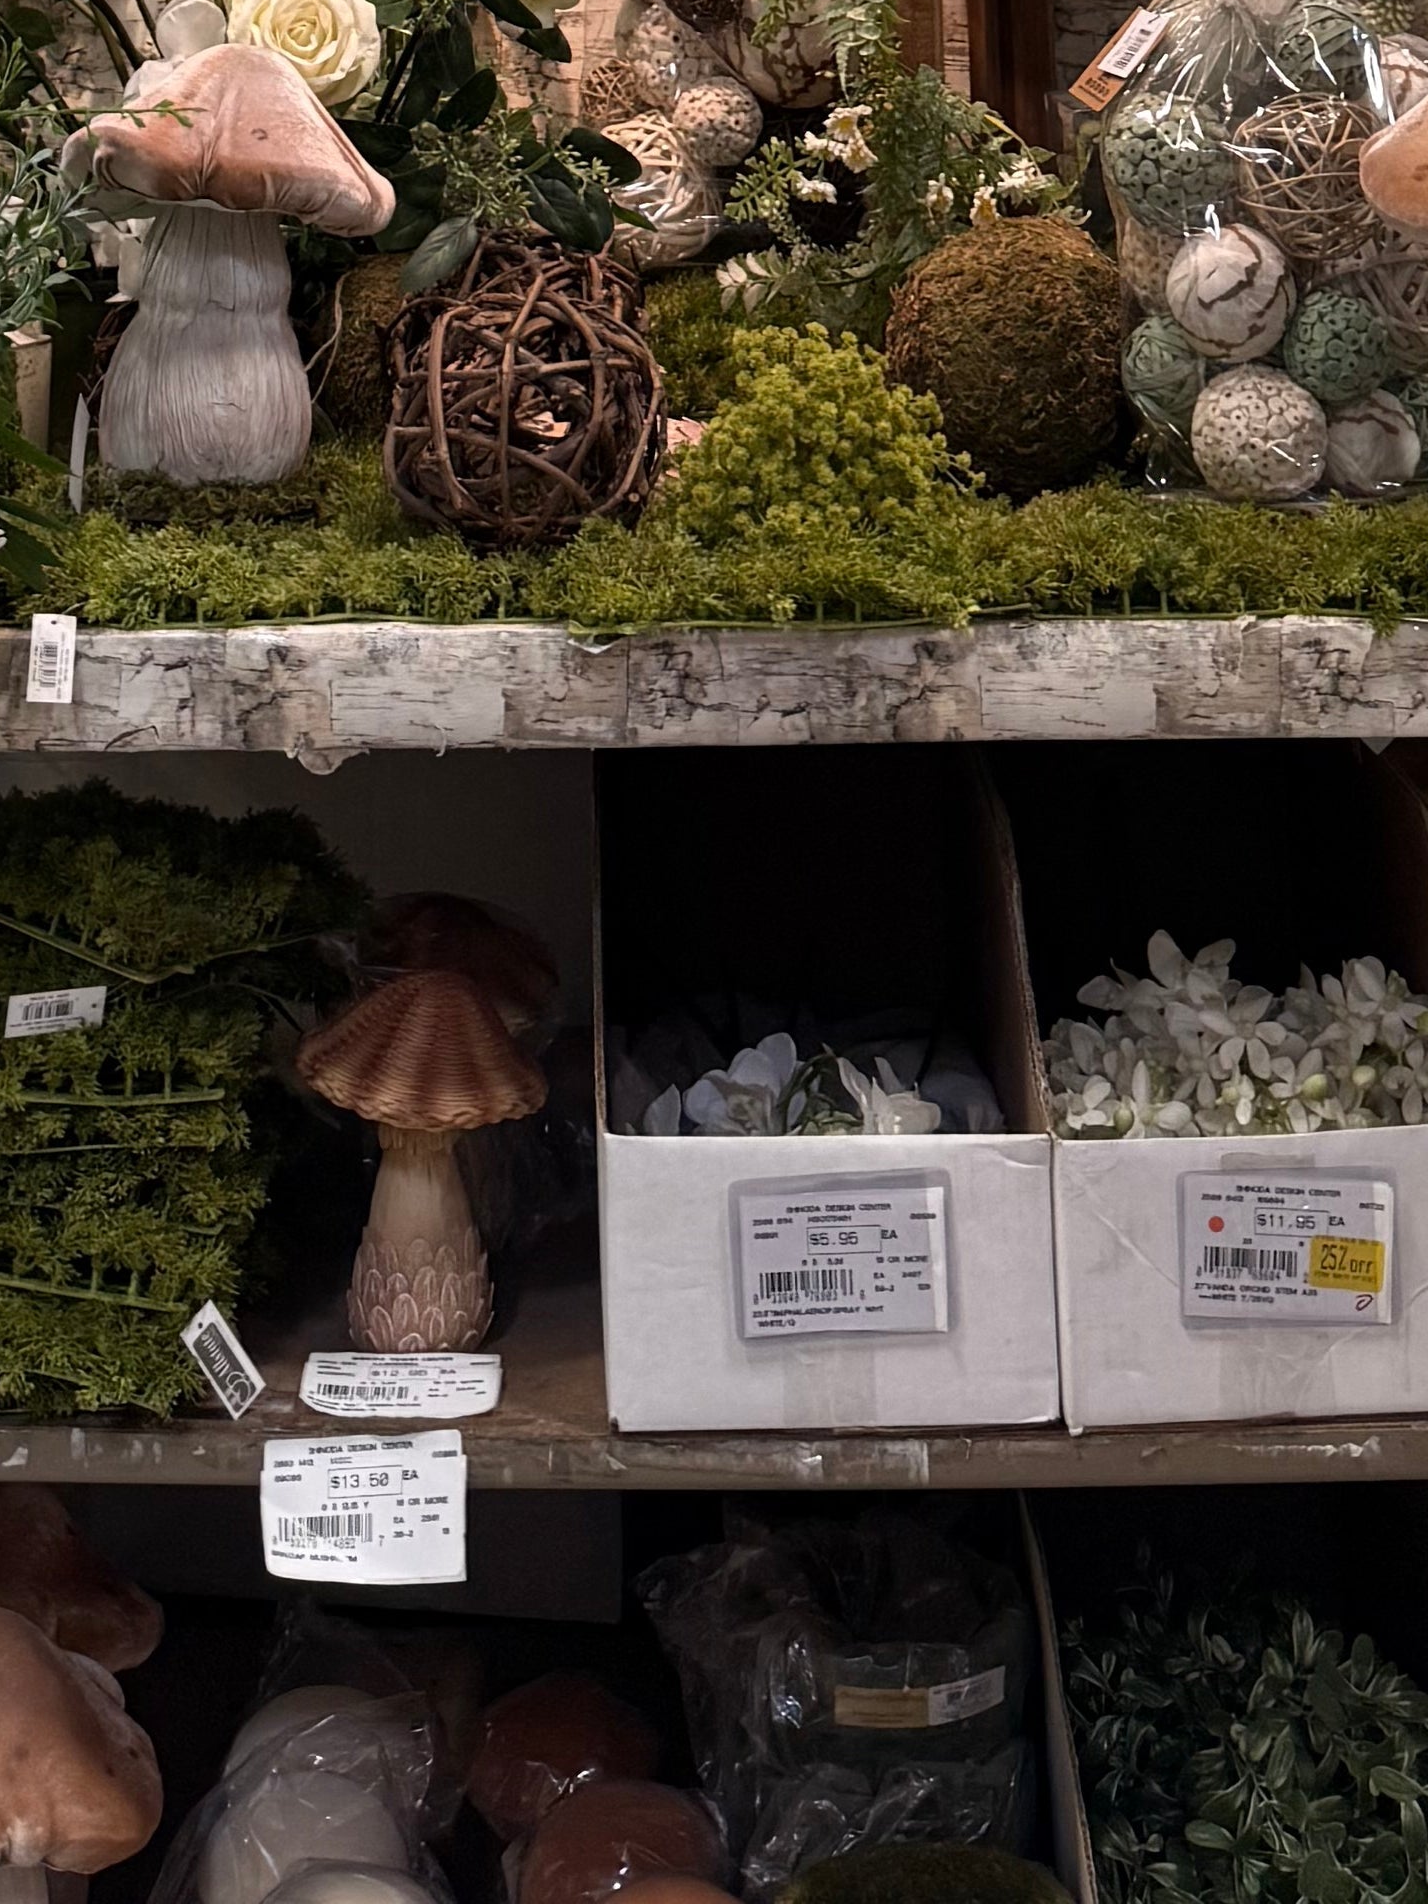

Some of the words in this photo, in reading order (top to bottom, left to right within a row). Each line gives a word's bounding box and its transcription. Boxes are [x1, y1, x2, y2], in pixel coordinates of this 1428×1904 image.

[1328, 1215, 1345, 1227] EA
[880, 1229, 898, 1241] EA
[1320, 1244, 1348, 1272] 25%
[330, 1472, 389, 1489] $13.50
[402, 1469, 419, 1481] EA
